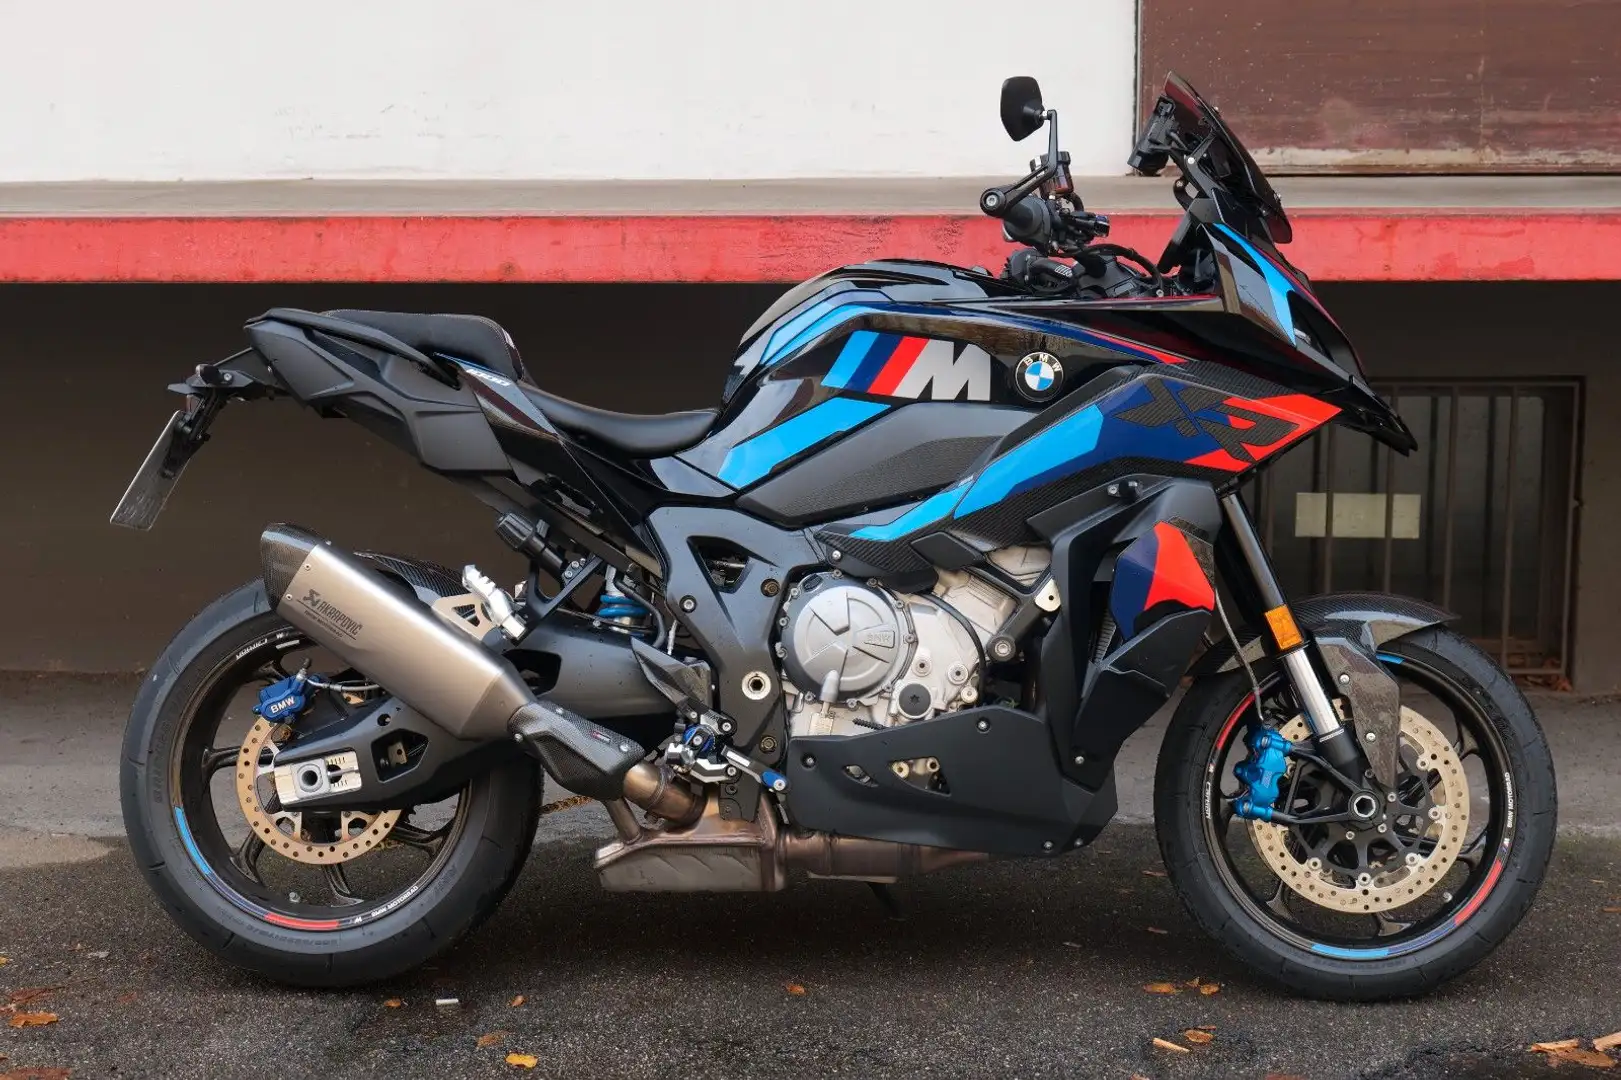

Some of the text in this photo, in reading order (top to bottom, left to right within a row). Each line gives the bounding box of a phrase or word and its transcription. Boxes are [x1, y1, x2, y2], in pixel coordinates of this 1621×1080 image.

[892, 338, 991, 401] M
[1022, 353, 1062, 373] BMW
[1113, 376, 1301, 462] XR
[270, 696, 295, 715] BMW
[1504, 771, 1514, 810] MOTORRAD
[371, 907, 387, 917] BMW
[387, 885, 419, 909] MOTORRAD
